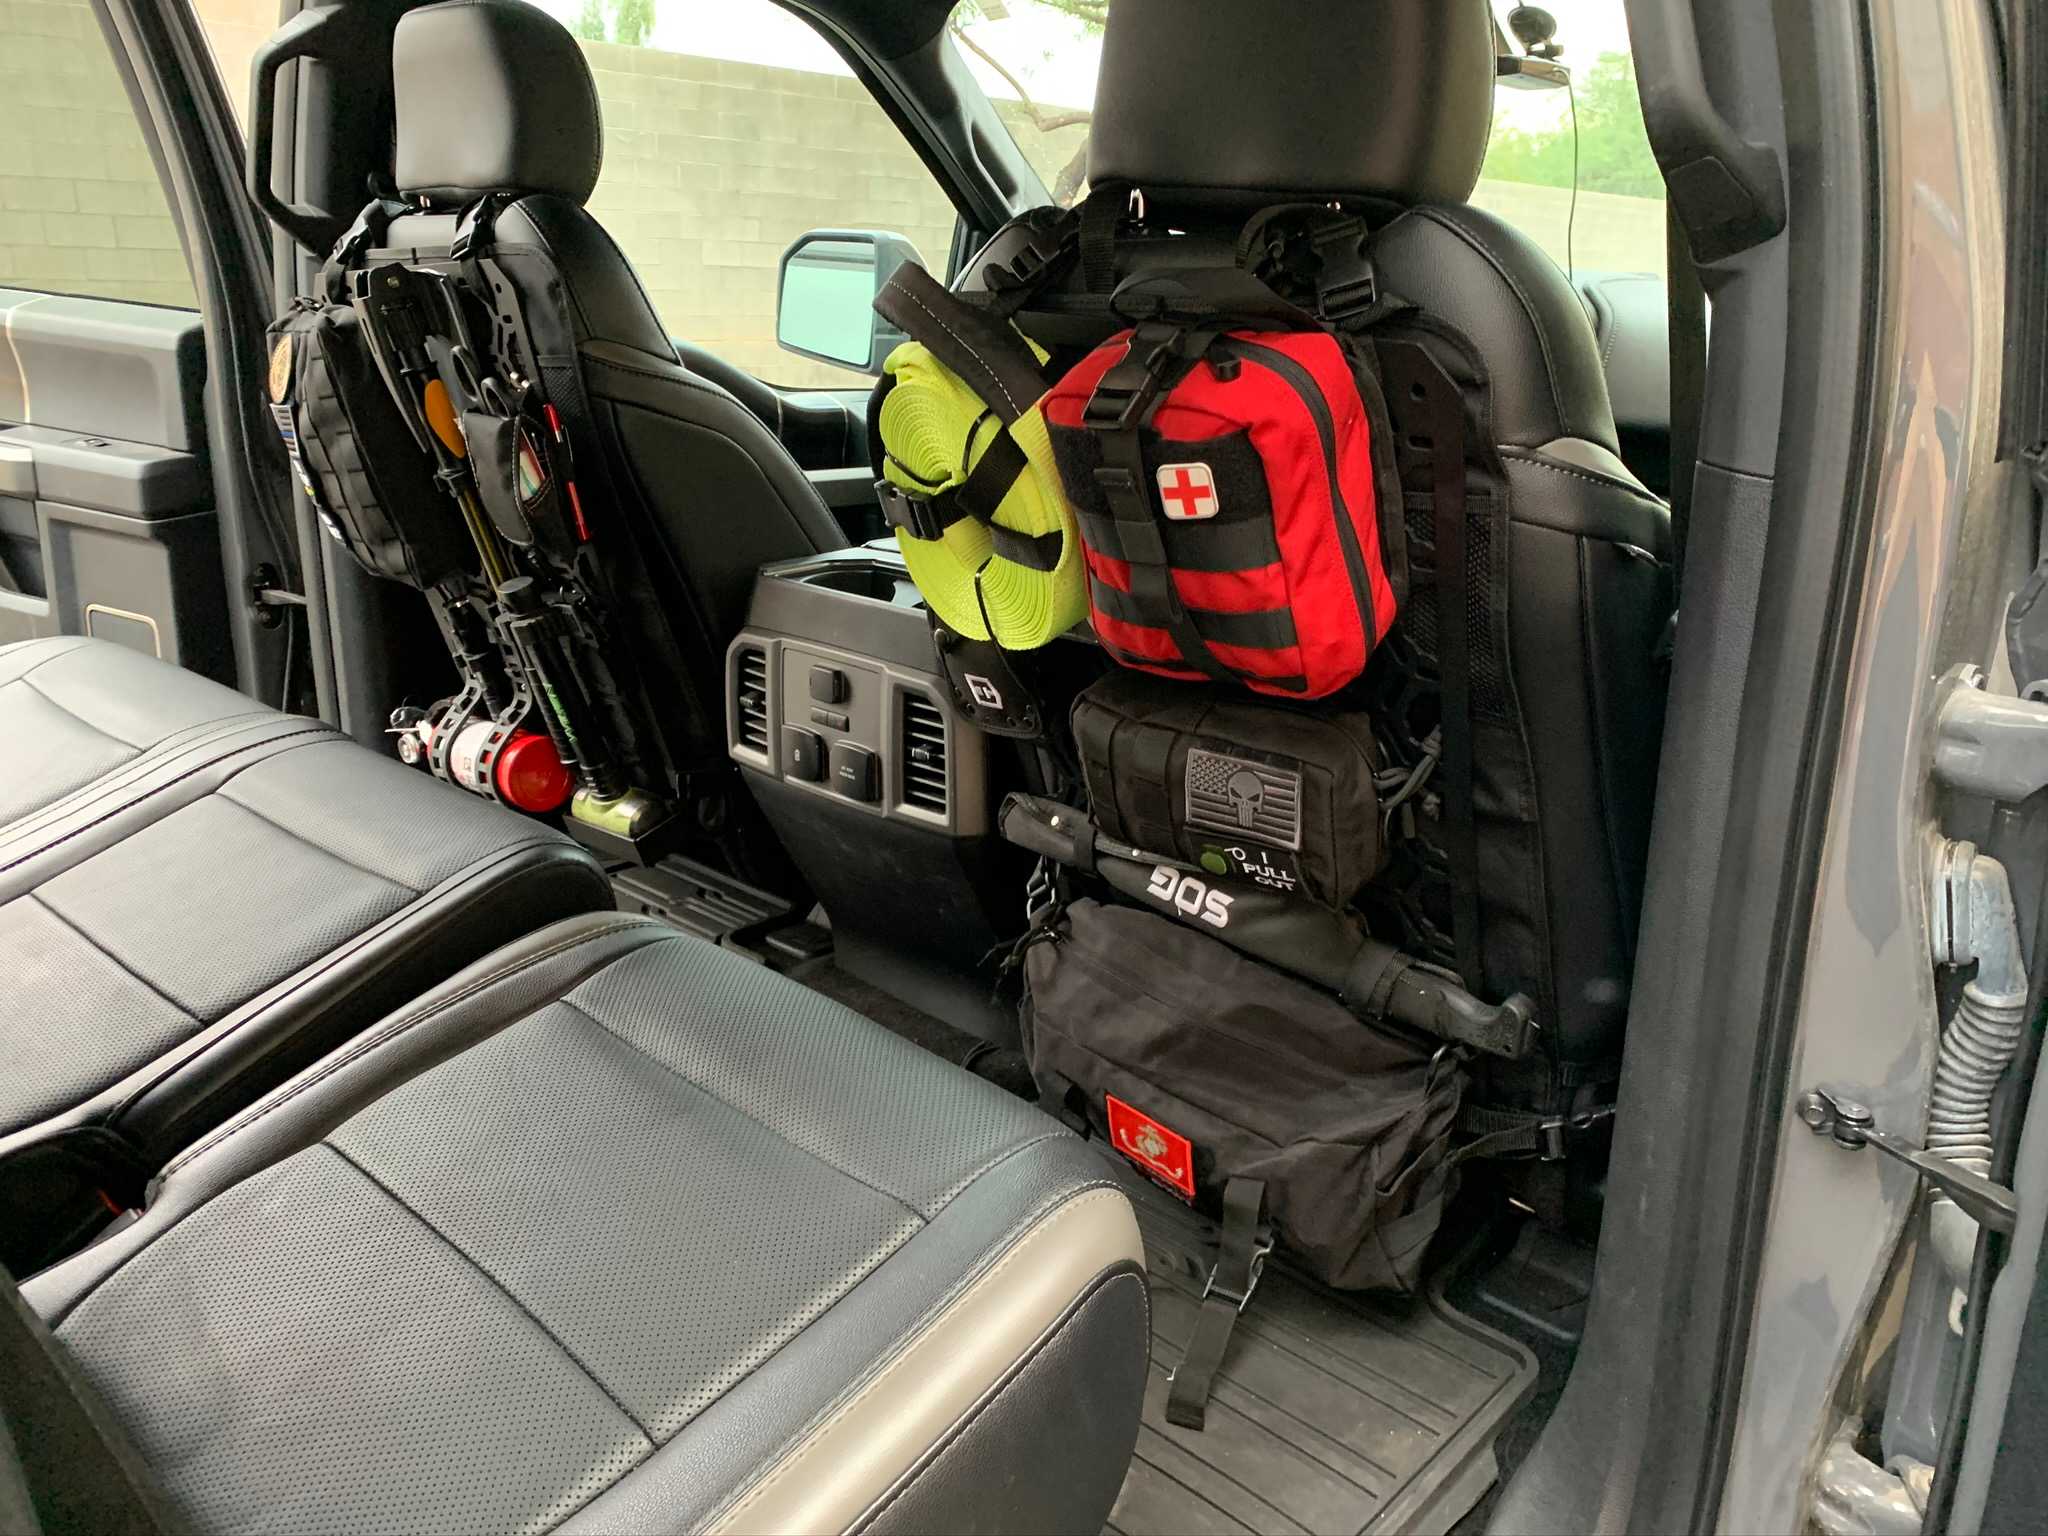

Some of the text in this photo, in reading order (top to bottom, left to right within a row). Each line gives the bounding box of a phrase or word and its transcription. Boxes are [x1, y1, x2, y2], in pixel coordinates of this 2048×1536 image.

[1242, 862, 1296, 883] PULL
[1254, 875, 1297, 892] OUT
[1146, 863, 1235, 929] SOG
